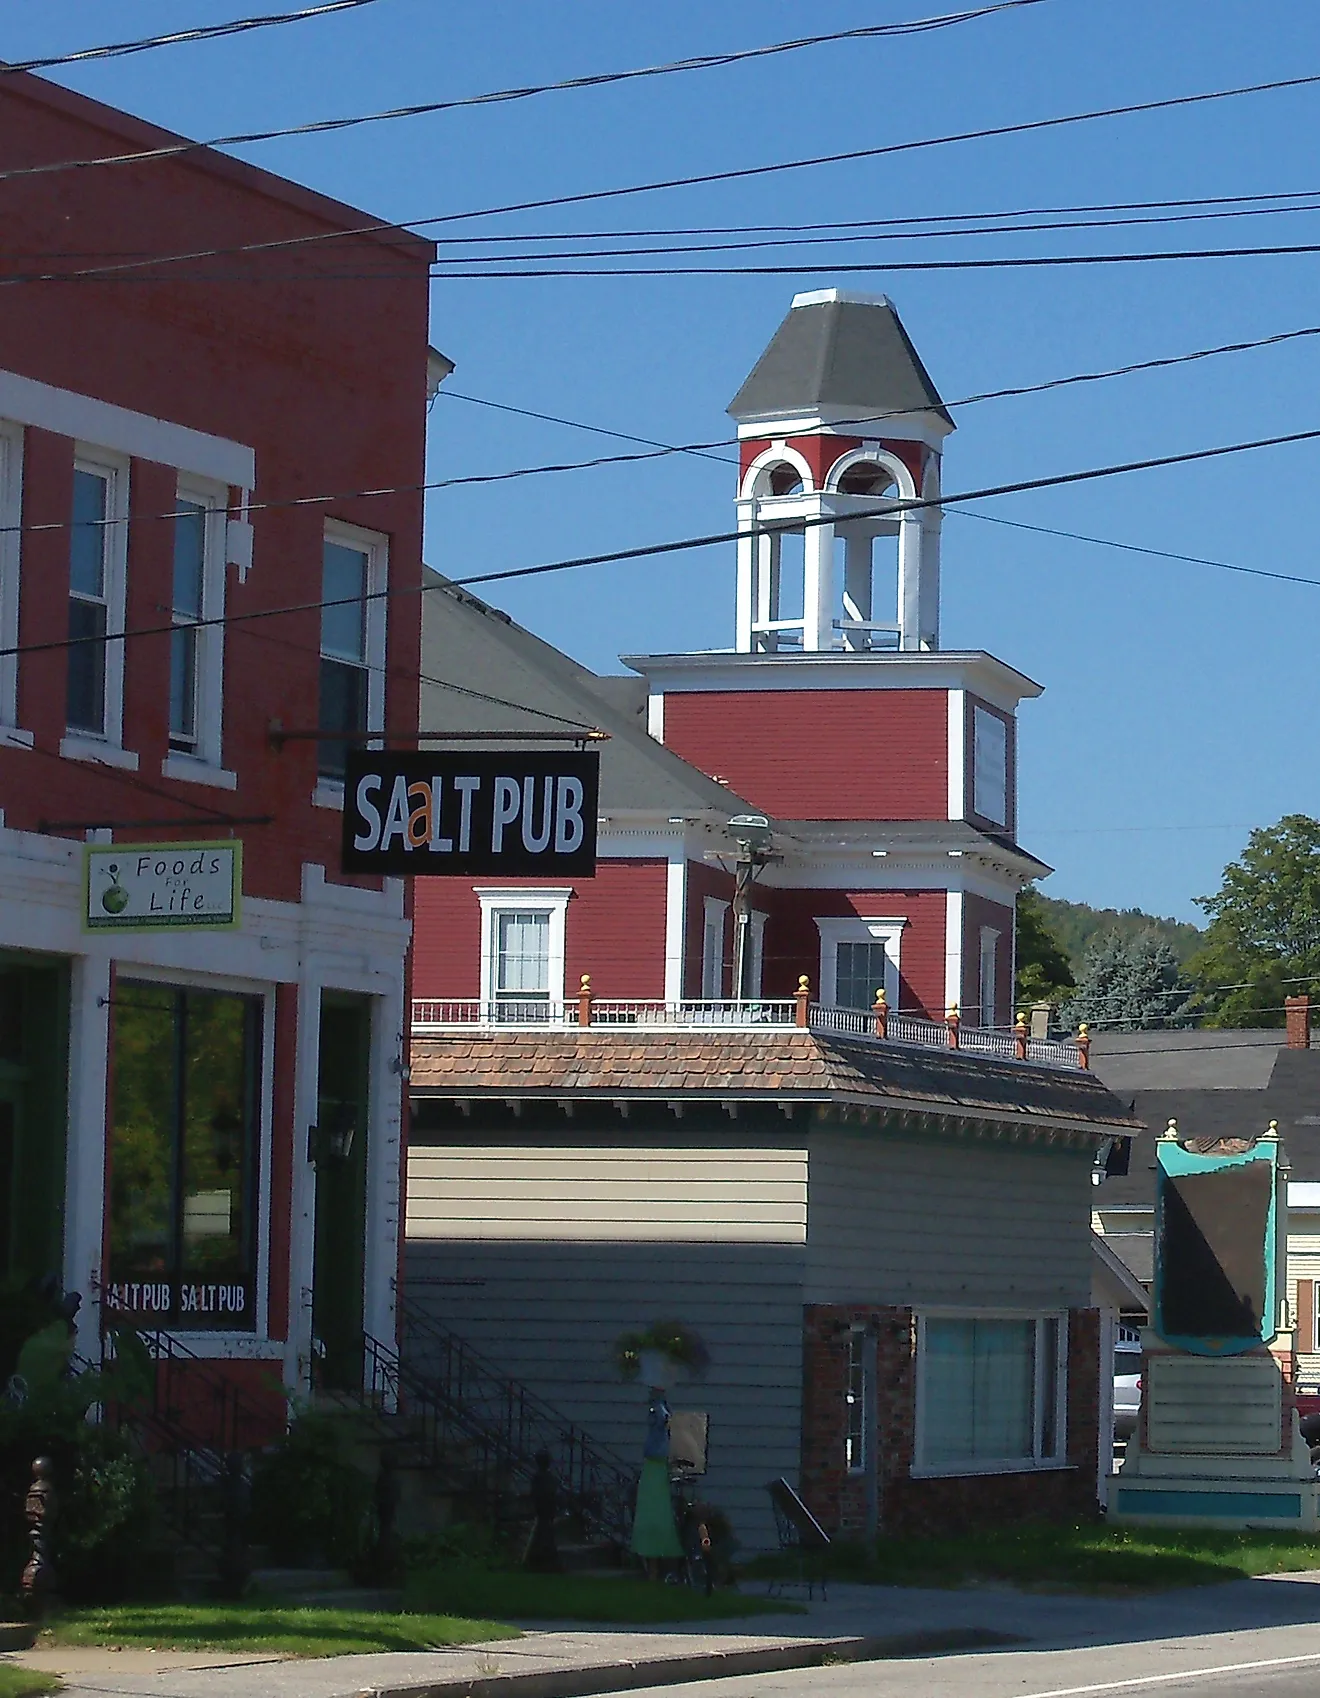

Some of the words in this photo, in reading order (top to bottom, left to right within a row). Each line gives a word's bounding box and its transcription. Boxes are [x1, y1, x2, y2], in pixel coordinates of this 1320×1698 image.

[491, 776, 584, 853] PUB
[136, 853, 220, 876] Foods
[150, 888, 204, 911] Life
[142, 1284, 171, 1311] PUB
[218, 1286, 245, 1312] PUB
